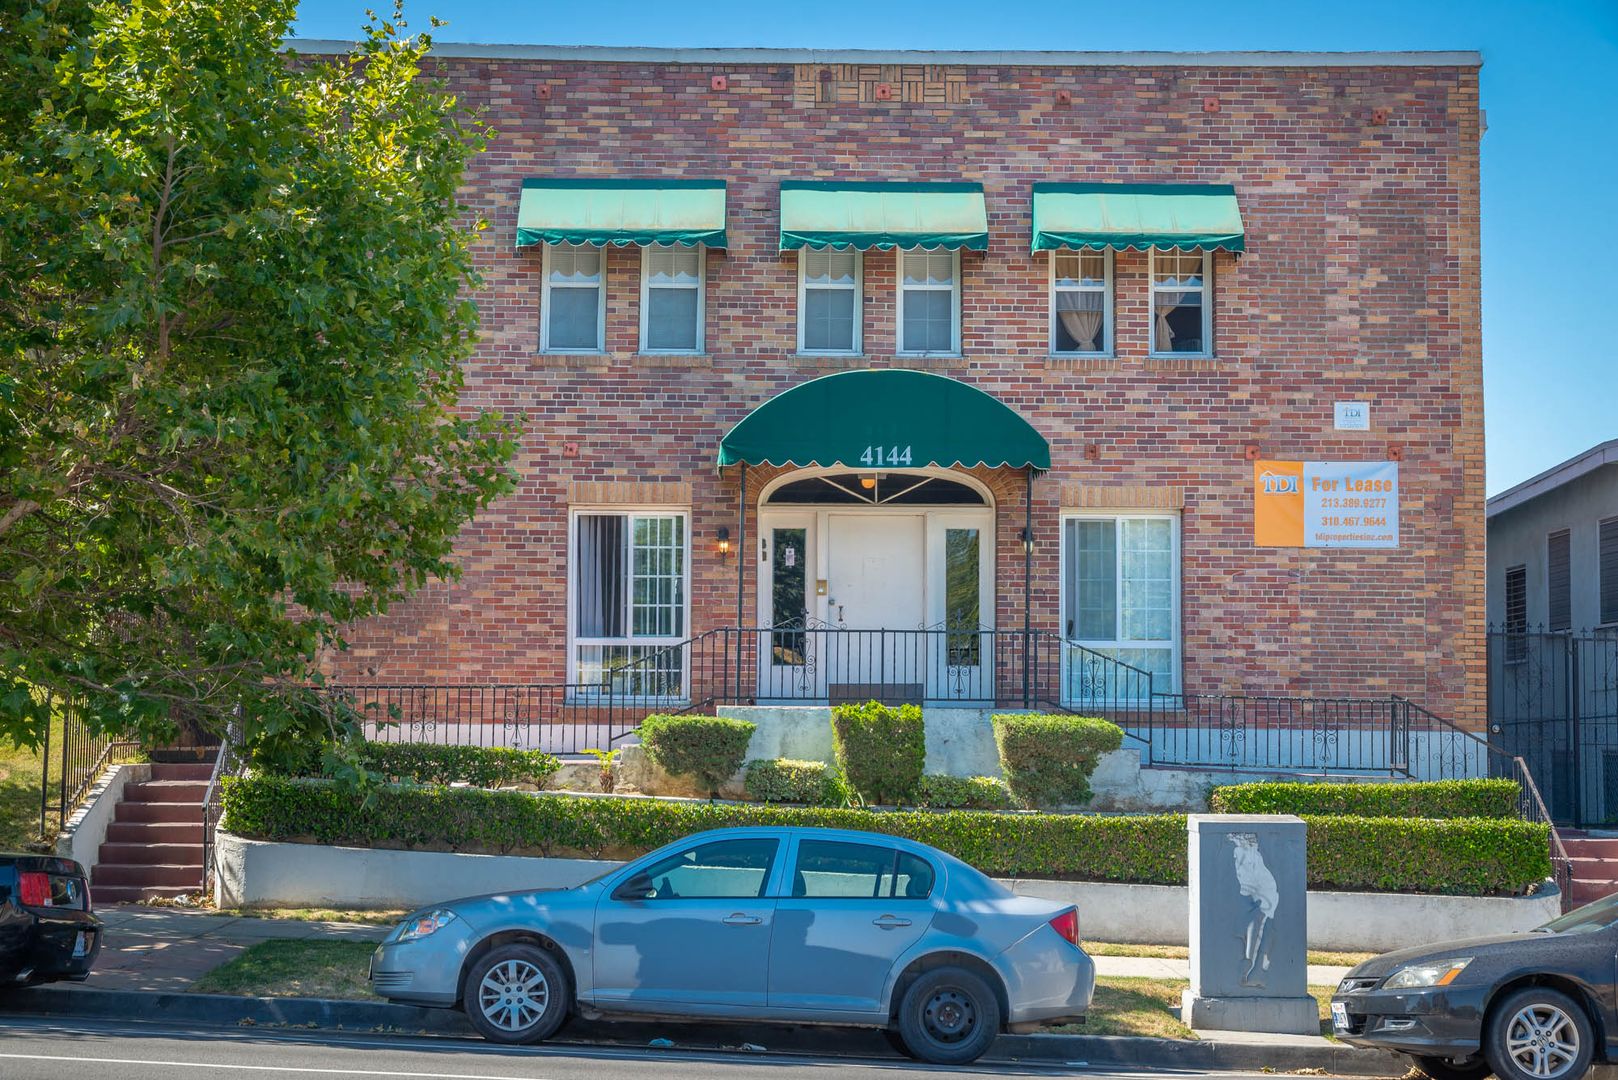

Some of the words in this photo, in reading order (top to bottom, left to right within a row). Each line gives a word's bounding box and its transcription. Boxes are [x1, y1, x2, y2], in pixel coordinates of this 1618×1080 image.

[860, 445, 912, 465] 4144
[1260, 473, 1299, 493] TDI
[1311, 476, 1338, 492] For
[1345, 476, 1393, 492] Lease
